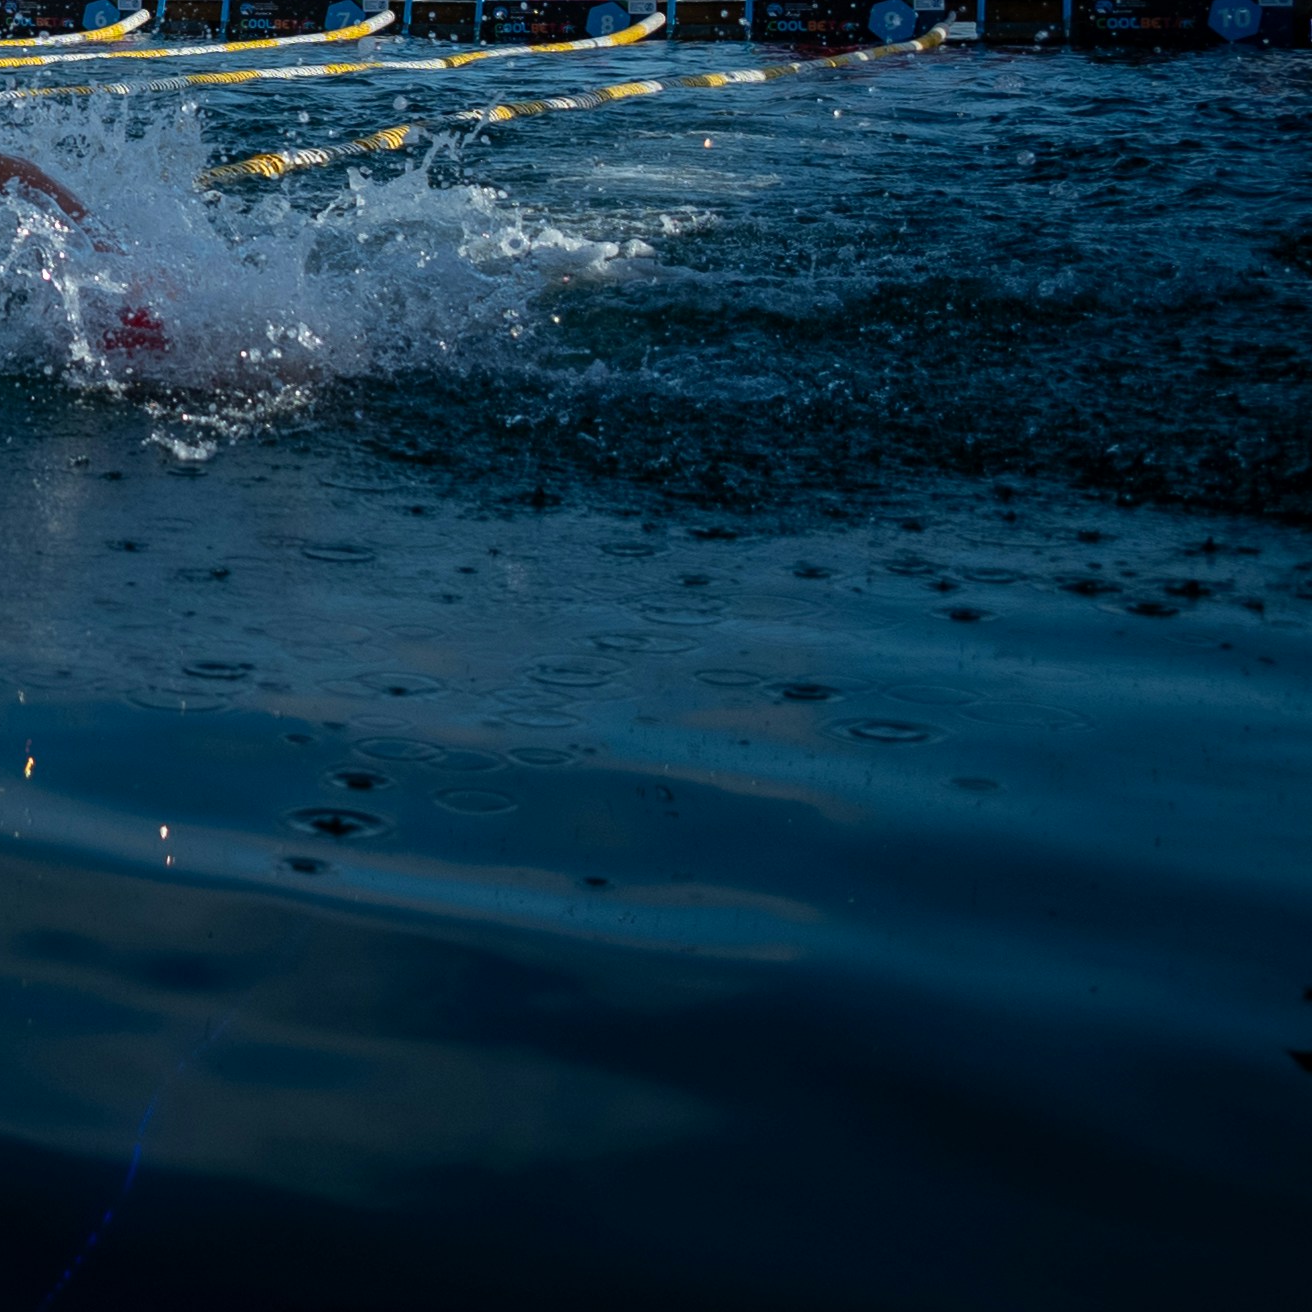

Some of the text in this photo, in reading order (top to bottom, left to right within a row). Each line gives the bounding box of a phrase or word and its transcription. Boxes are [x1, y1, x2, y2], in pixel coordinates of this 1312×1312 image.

[94, 10, 106, 27] 6
[336, 11, 351, 29] 7
[600, 14, 614, 34] 8
[883, 10, 902, 31] 9
[1218, 6, 1251, 29] 10
